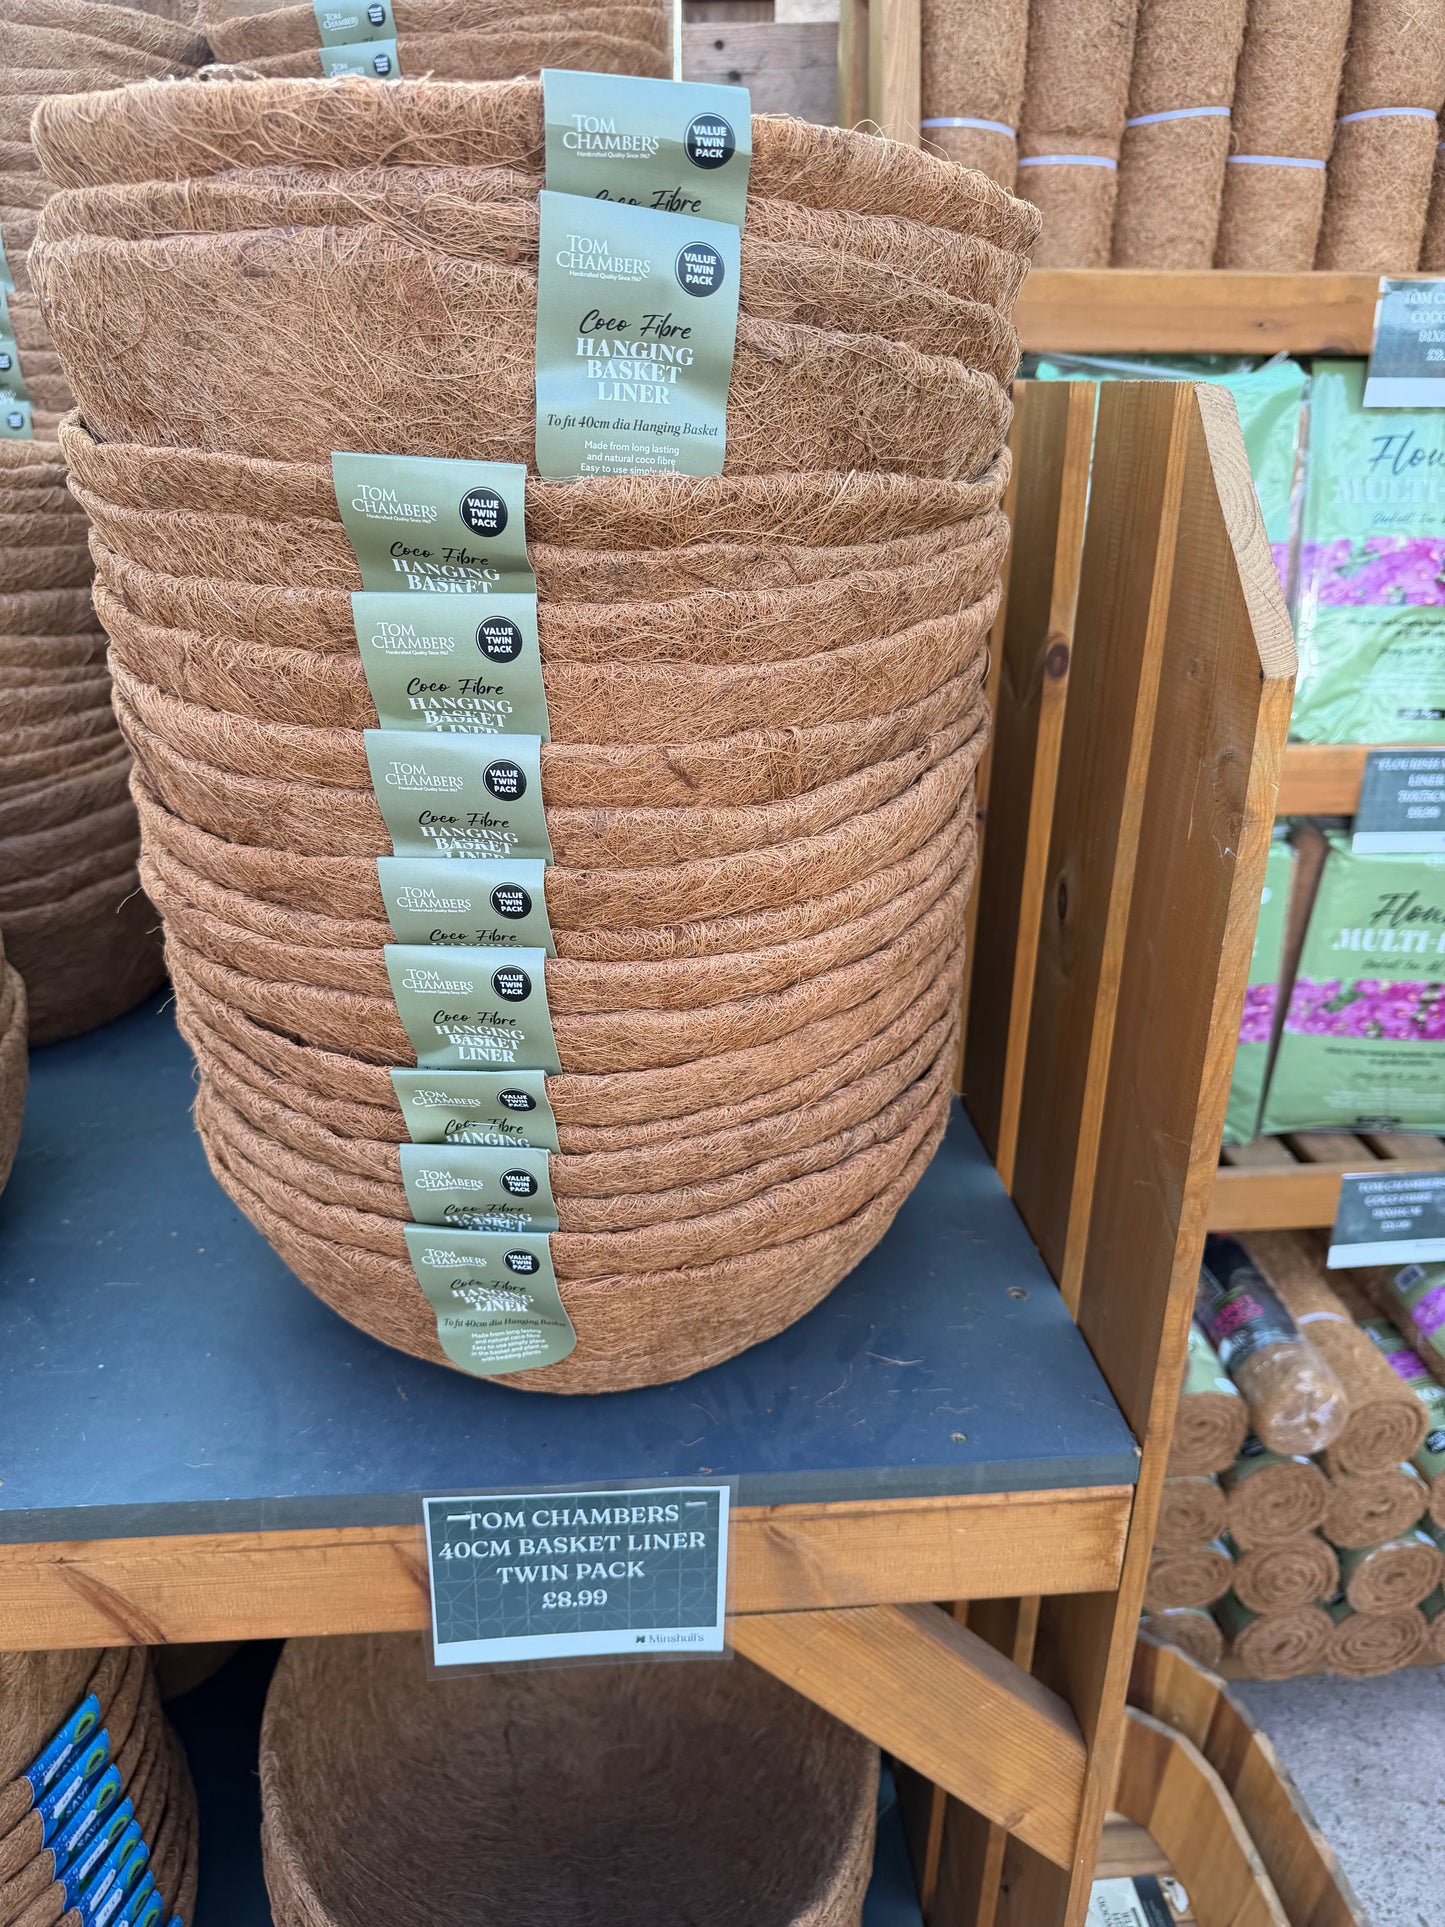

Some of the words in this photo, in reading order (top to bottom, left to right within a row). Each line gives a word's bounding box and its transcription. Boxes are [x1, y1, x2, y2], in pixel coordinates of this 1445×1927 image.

[572, 114, 616, 134] TOM
[693, 125, 727, 136] VALUE
[563, 132, 660, 155] CHAMBERS
[695, 136, 724, 148] TWIN
[608, 152, 626, 160] Quality
[695, 148, 724, 158] PACK
[651, 186, 702, 212] Fibre
[566, 234, 609, 255] TOM
[556, 250, 651, 278] CHAMBERS
[684, 252, 717, 265] VALUE
[686, 263, 714, 275] TWIN
[600, 272, 617, 282] Quality
[618, 274, 630, 282] Since
[686, 274, 714, 286] PACK
[579, 309, 632, 334] Coco
[640, 312, 692, 340] Fibre
[576, 337, 695, 366] HANGING
[587, 359, 682, 384] BASKET
[597, 382, 671, 405] LINER
[547, 414, 562, 426] To
[561, 415, 576, 430] fit
[578, 416, 610, 430] 40cm
[612, 418, 631, 430] dia
[632, 420, 681, 436] Hanging
[683, 422, 718, 436] Basket
[584, 440, 608, 450] Made
[610, 441, 630, 451] from
[632, 443, 651, 454] long
[652, 444, 680, 456] lasting
[586, 453, 603, 462] and
[604, 454, 634, 464] natural
[657, 456, 676, 466] fibre
[580, 463, 600, 474] Easy
[602, 464, 612, 472] to
[612, 466, 628, 474] use
[358, 484, 398, 502] TOM
[352, 498, 438, 522] CHAMBERS
[467, 498, 500, 509] VALUE
[470, 508, 497, 518] TWIN
[471, 518, 498, 528] PACK
[390, 541, 434, 558] Coco
[442, 548, 488, 566] Fibre
[392, 558, 500, 581] HANGING
[406, 574, 492, 594] BASKET
[377, 622, 416, 637] TOM
[482, 627, 514, 636] VALUE
[372, 636, 454, 652] CHAMBERS
[486, 636, 512, 645] TWIN
[488, 645, 513, 654] PACK
[407, 678, 450, 696] Coco
[458, 677, 504, 695] Fibre
[408, 697, 513, 714] HANGING
[423, 710, 506, 728] BASKET
[390, 762, 427, 776] TOM
[489, 770, 518, 778] VALUE
[385, 774, 464, 790] CHAMBERS
[492, 778, 517, 786] TWIN
[494, 786, 518, 794] PACK
[418, 810, 460, 825] Coco
[466, 812, 510, 828] Fibre
[420, 826, 518, 842] HANGING
[434, 838, 512, 854] BASKET
[400, 886, 436, 898] TOM
[396, 897, 472, 910] CHAMBERS
[430, 929, 469, 942] Coco
[476, 928, 518, 942] Fibre
[406, 968, 440, 980] TOM
[497, 974, 524, 982] VALUE
[402, 978, 474, 992] CHAMBERS
[433, 1010, 470, 1024] Coco
[478, 1011, 516, 1026] Fibre
[434, 1026, 525, 1040] HANGING
[448, 1034, 520, 1050] BASKET
[458, 1046, 516, 1062] LINER
[414, 1090, 448, 1098] TOM
[412, 1096, 481, 1107] CHAMBERS
[487, 1118, 524, 1134] Fibre
[445, 1131, 530, 1148] HANGING
[420, 1170, 452, 1180] TOM
[415, 1178, 484, 1191] CHAMBERS
[444, 1204, 480, 1215] Coco
[486, 1203, 524, 1212] Fibre
[444, 1212, 532, 1222] HANGING
[425, 1248, 456, 1258] TOM
[422, 1256, 488, 1266] CHAMBERS
[450, 1278, 484, 1290] Coco
[490, 1280, 528, 1292] Fibre
[475, 1300, 528, 1312] LINER
[444, 1318, 454, 1326] To
[454, 1318, 464, 1328] fit
[465, 1320, 488, 1328] 40cm
[489, 1318, 502, 1327] dia
[504, 1318, 540, 1326] Hanging
[488, 1336, 510, 1344] natural
[468, 1512, 525, 1530] TOM
[532, 1504, 679, 1528] CHAMBERS
[438, 1539, 512, 1560] 40CM
[519, 1535, 620, 1556] BASKET
[628, 1532, 706, 1550] LINER
[496, 1563, 568, 1584] TWIN
[576, 1561, 646, 1580] PACK
[542, 1589, 608, 1610] £8.99
[649, 1632, 704, 1644] Minshull's
